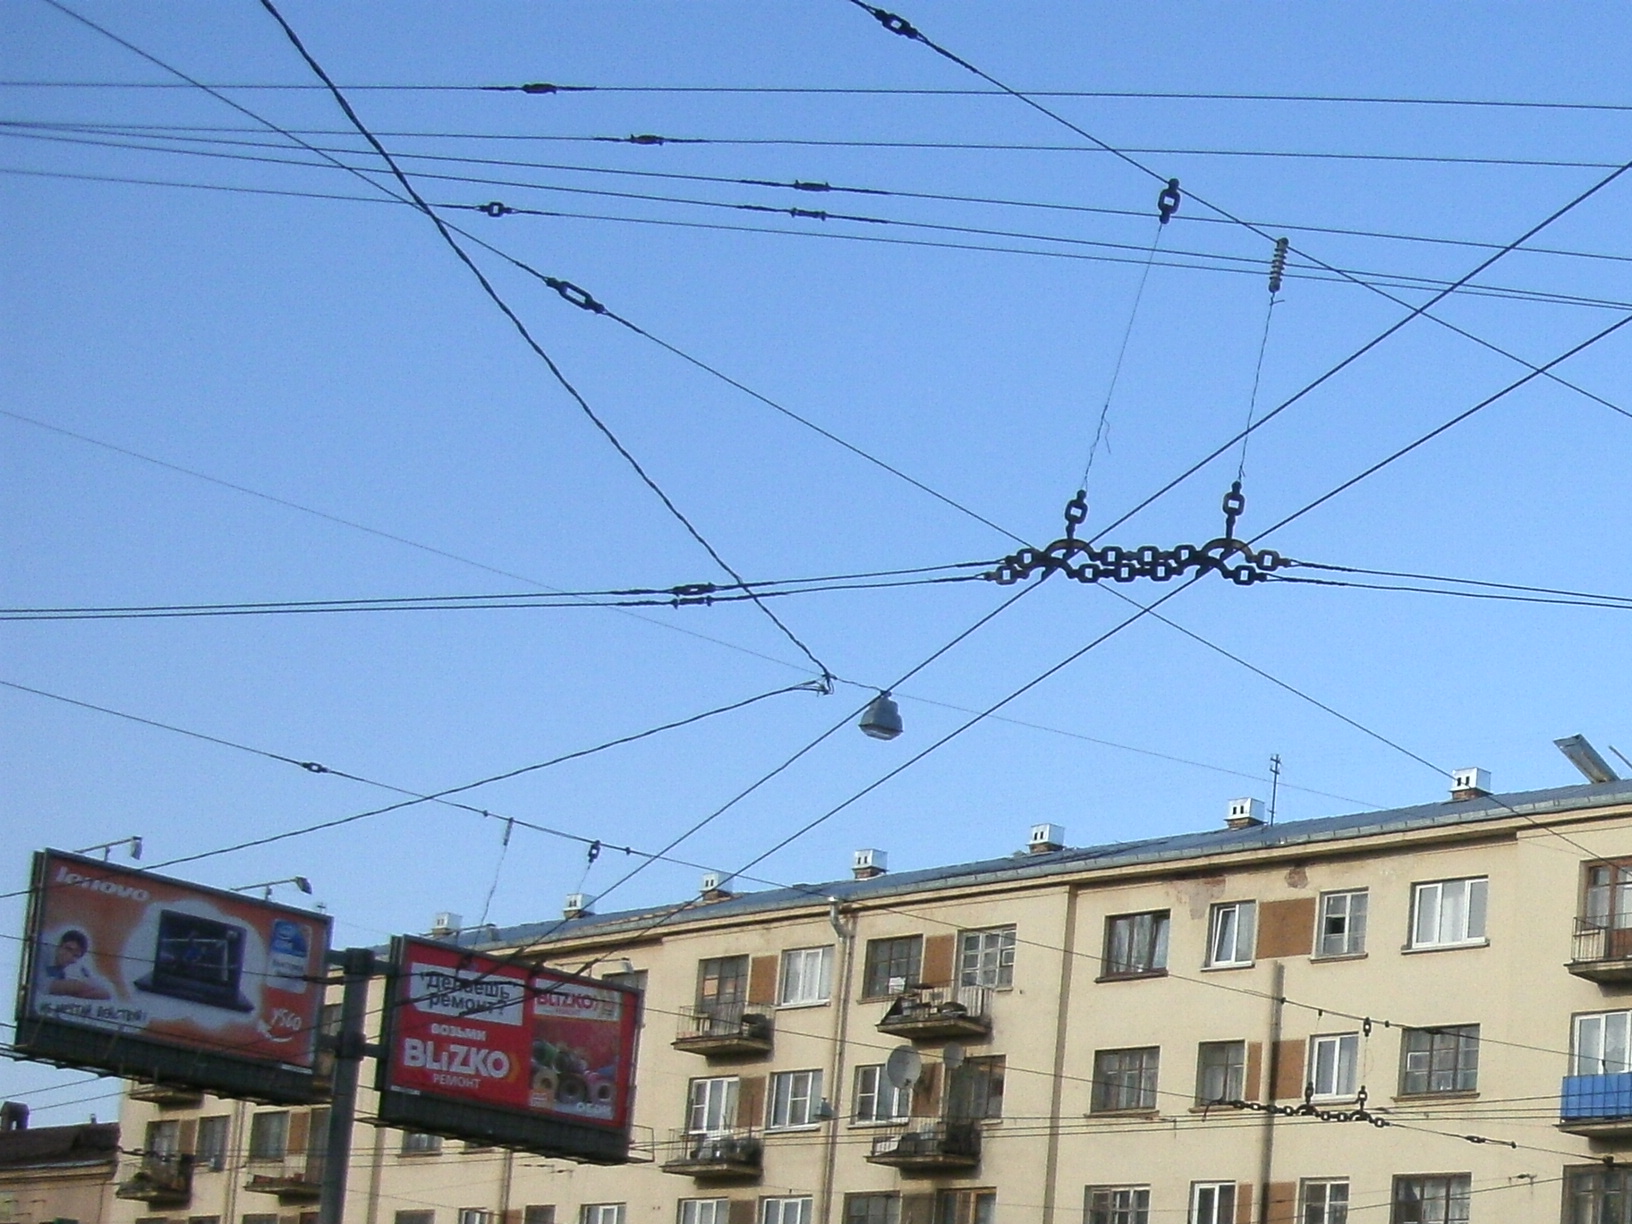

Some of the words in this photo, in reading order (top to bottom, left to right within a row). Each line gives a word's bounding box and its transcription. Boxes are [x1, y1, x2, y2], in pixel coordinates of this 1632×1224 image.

[56, 867, 149, 901] lenovo
[431, 1022, 487, 1042] возьми
[433, 1073, 481, 1090] РЕМОНТ
